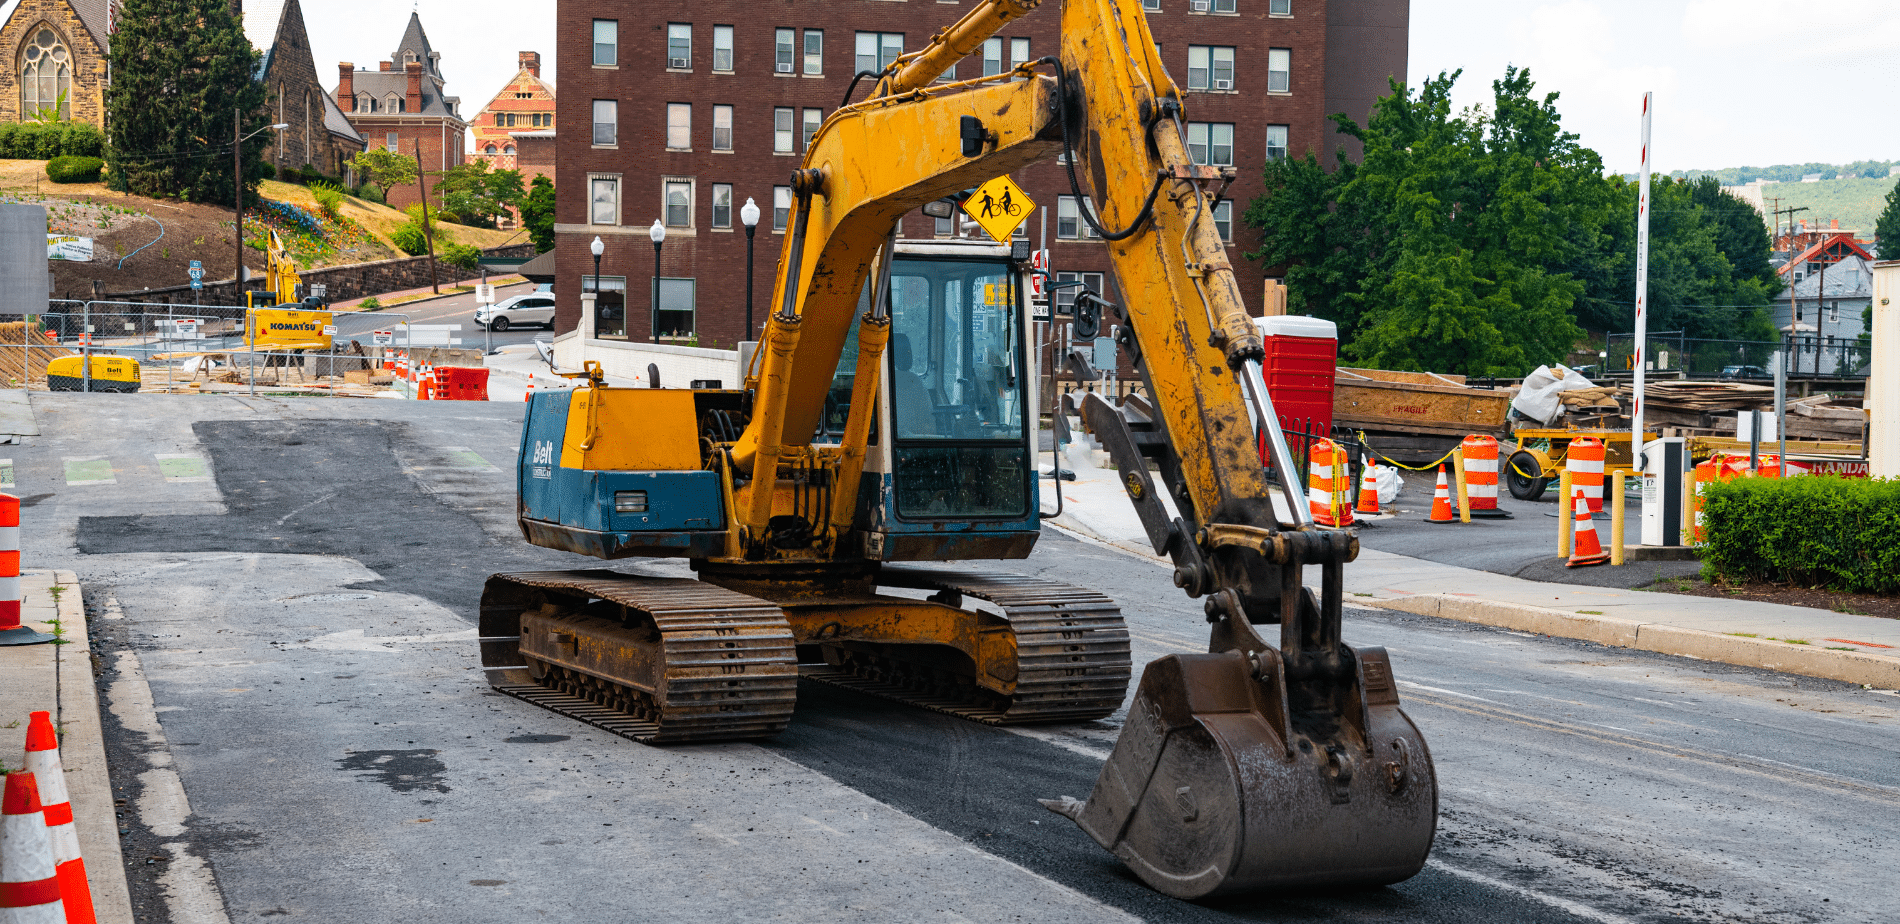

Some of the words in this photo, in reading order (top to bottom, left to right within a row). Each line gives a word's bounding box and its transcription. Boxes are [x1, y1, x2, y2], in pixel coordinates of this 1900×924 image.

[269, 321, 316, 331] KOMATSU
[1393, 405, 1428, 414] FRAGILE
[532, 440, 552, 464] Belt
